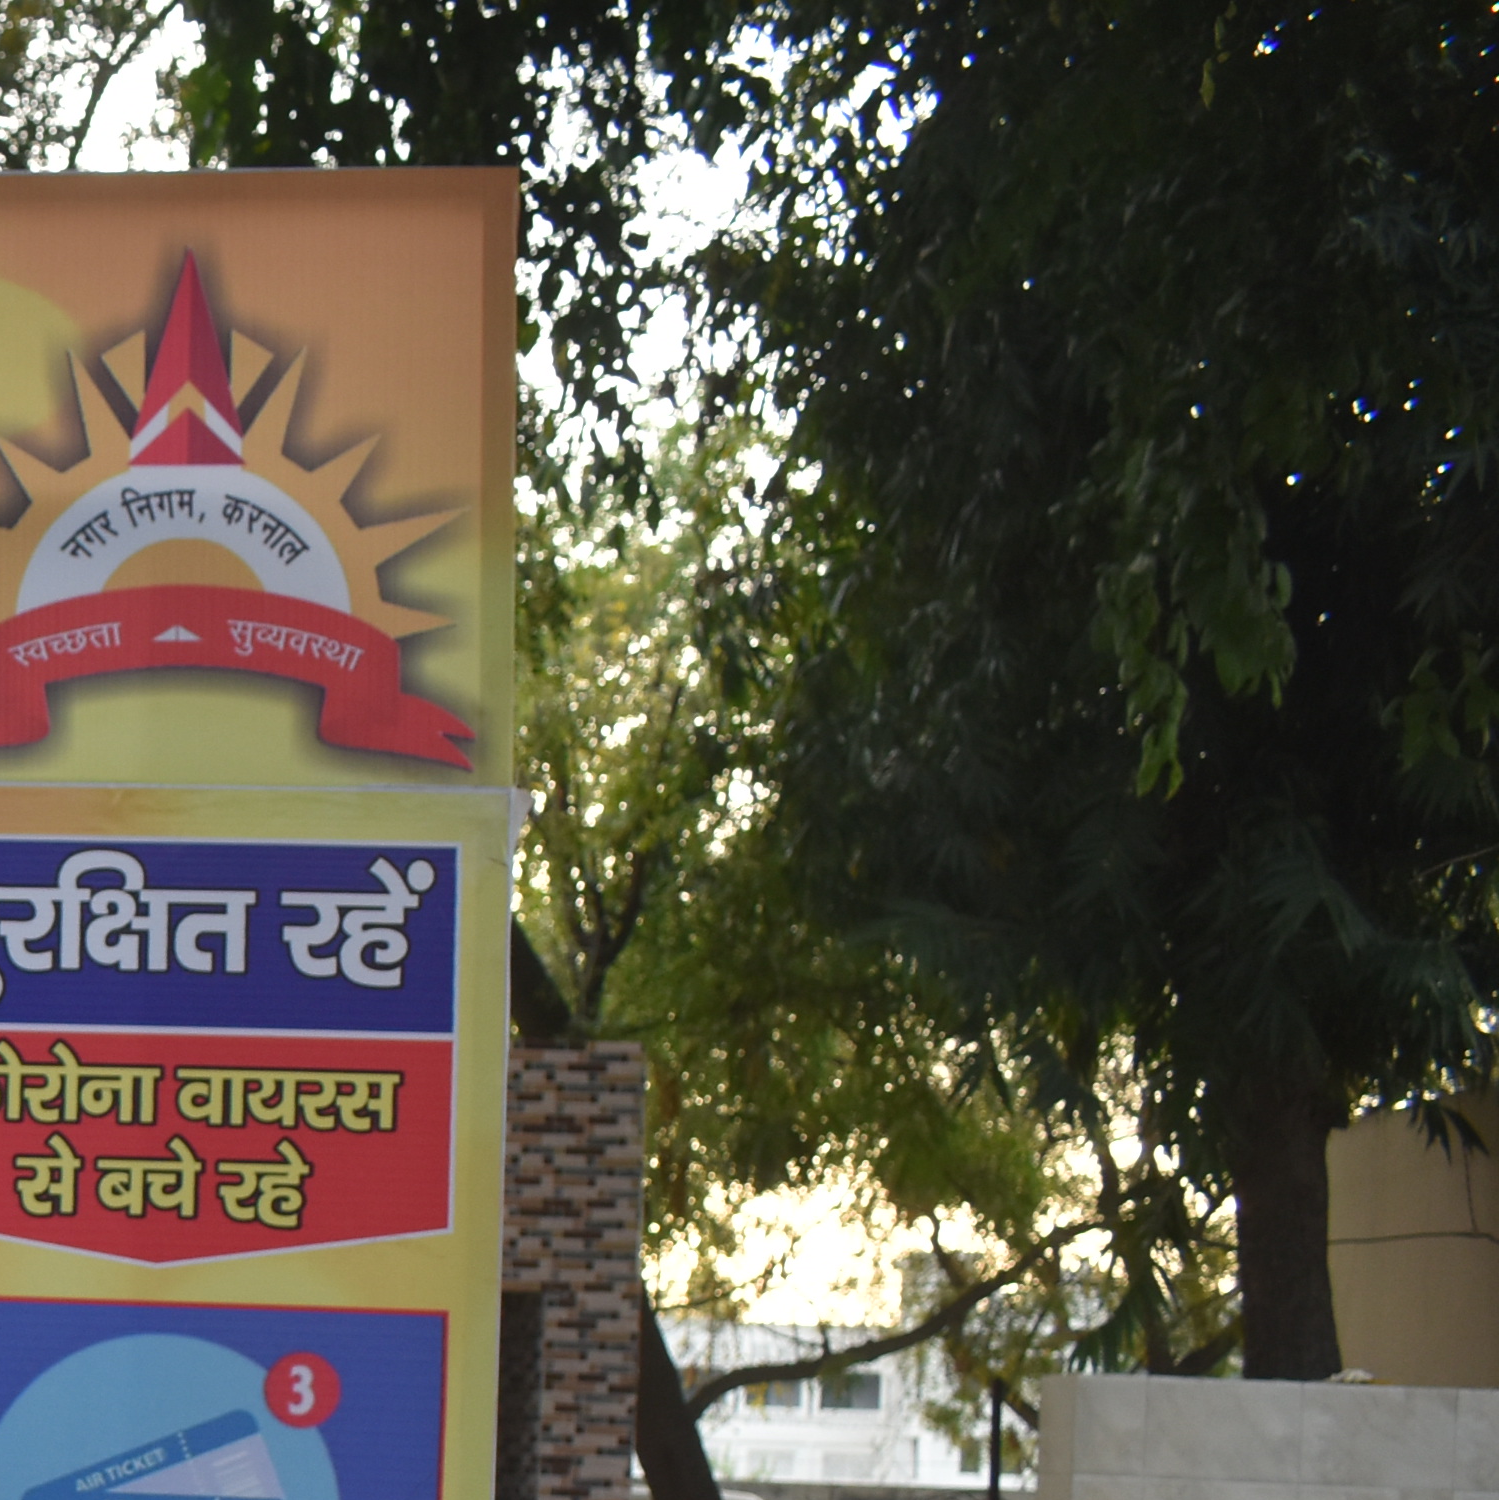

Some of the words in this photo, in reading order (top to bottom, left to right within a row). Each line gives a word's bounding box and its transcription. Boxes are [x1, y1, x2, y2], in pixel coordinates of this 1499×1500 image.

[60, 508, 116, 563] नगर
[221, 494, 310, 566] करनाल
[8, 620, 123, 668] स्वच्छता
[227, 617, 365, 673] सुव्यवस्था
[281, 857, 436, 988] रहें
[175, 1066, 403, 1132] वायरस
[14, 1133, 81, 1217] से
[96, 1137, 202, 1220] बचे
[216, 1139, 313, 1230] रहे
[287, 1365, 316, 1416] 3
[75, 1470, 106, 1493] AIR
[106, 1446, 167, 1483] TICKET
